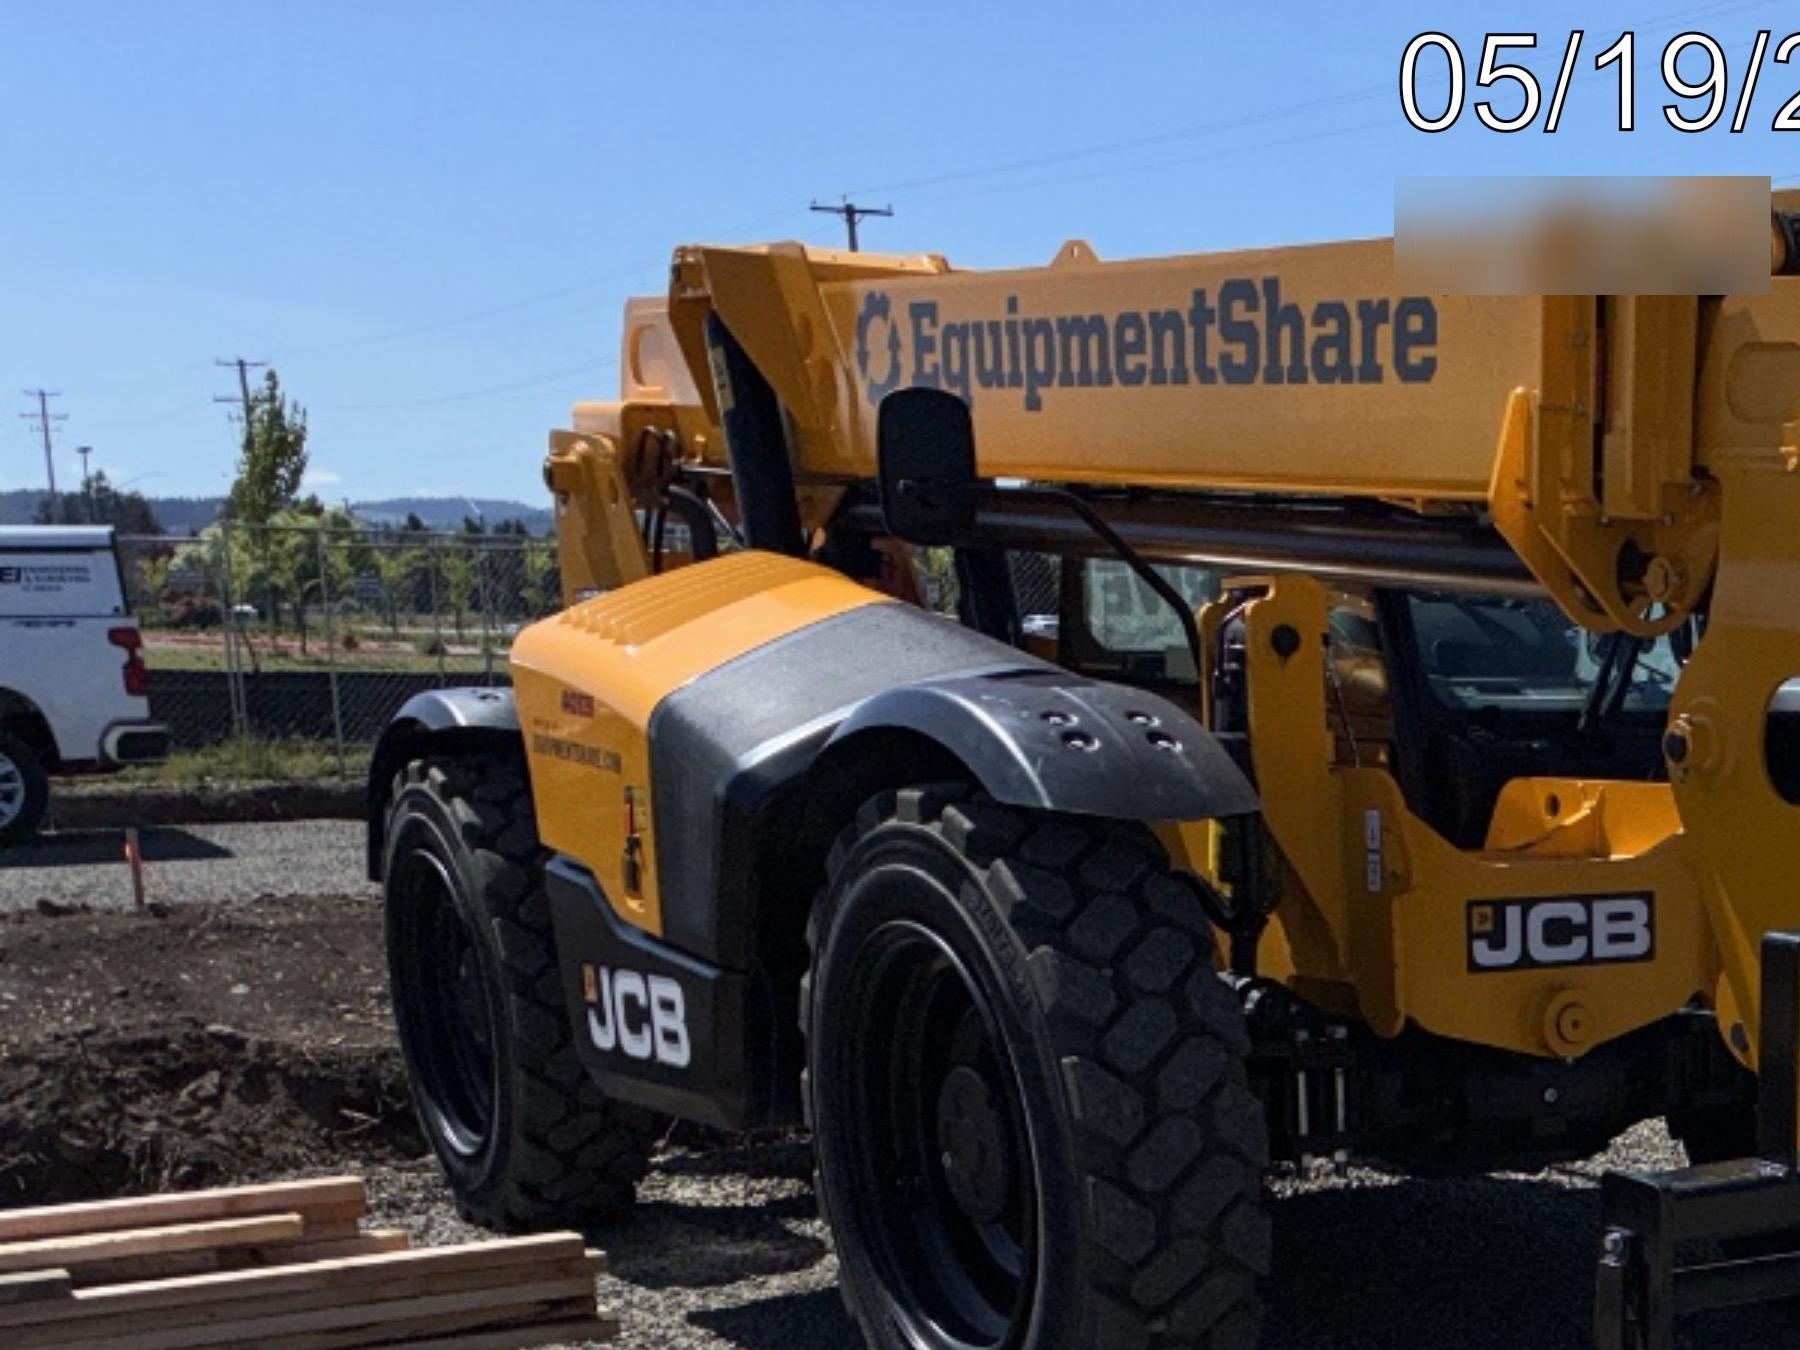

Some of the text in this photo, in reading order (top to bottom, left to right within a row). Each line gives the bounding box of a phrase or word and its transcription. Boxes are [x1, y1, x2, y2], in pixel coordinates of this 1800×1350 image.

[910, 277, 1438, 411] EquipmentShare
[1472, 900, 1650, 967] JCB
[587, 965, 691, 1069] JCB
